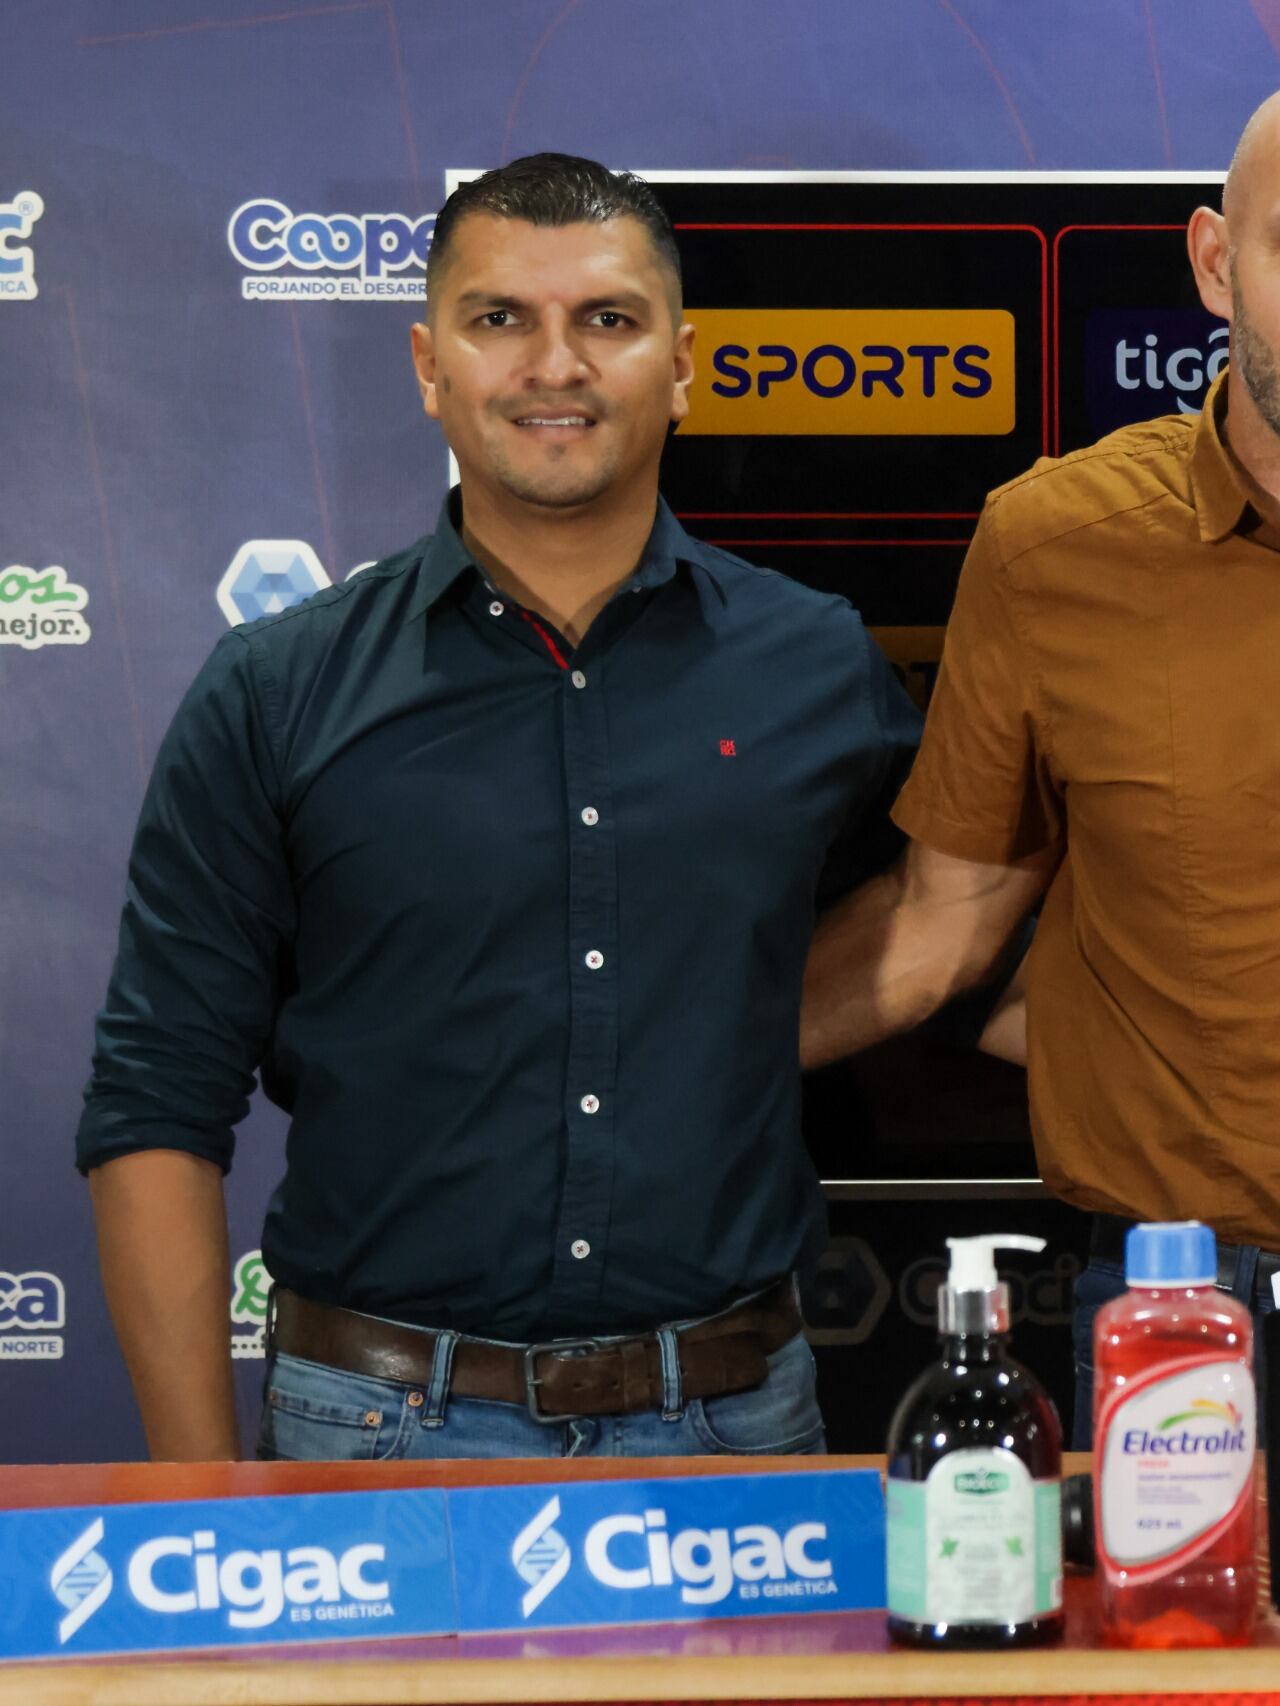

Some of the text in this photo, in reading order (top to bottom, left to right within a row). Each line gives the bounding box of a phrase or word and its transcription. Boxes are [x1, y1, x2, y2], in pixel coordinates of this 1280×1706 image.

[246, 282, 336, 294] FORJANDO
[341, 283, 359, 294] EL
[711, 344, 992, 398] SPORTS
[2, 1342, 58, 1353] NORTE
[1122, 1429, 1246, 1455] Electrolit
[585, 1508, 833, 1605] Cigac
[127, 1530, 390, 1628] Cigac
[739, 1584, 760, 1599] ES
[290, 1608, 312, 1622] ES
